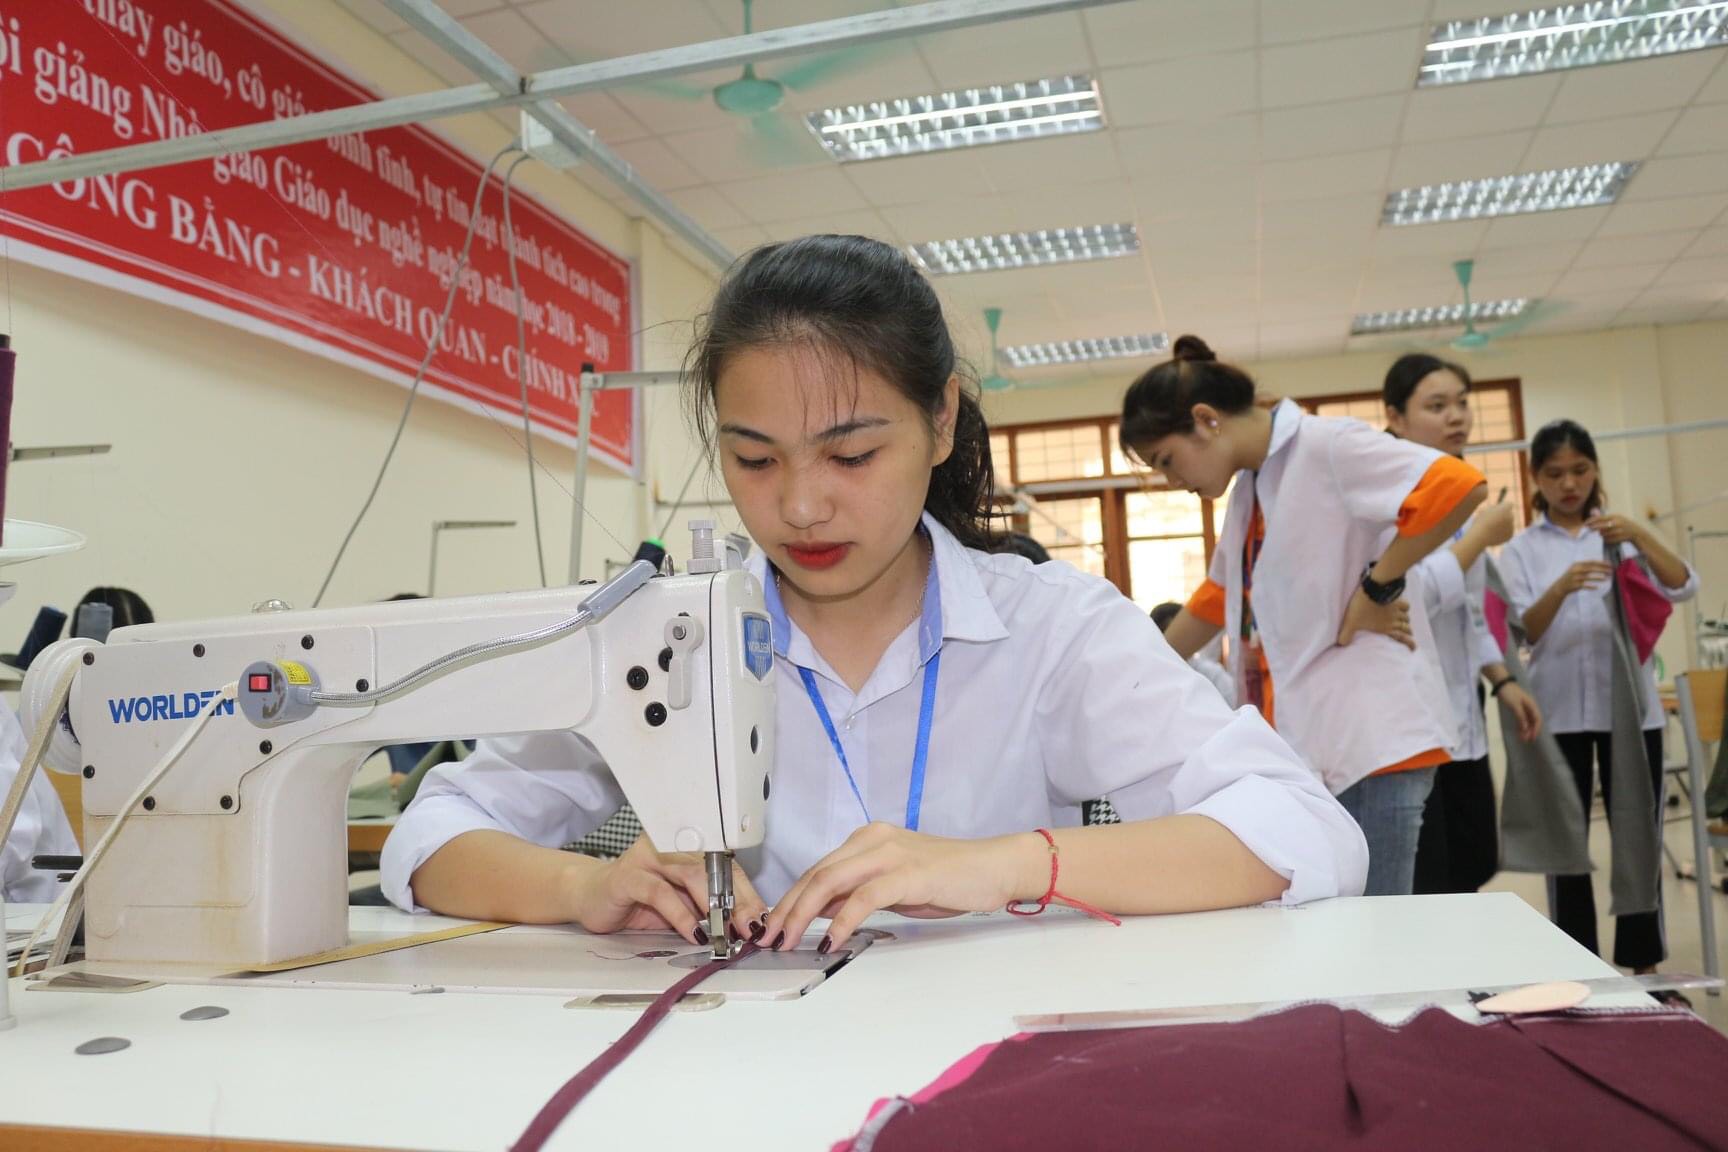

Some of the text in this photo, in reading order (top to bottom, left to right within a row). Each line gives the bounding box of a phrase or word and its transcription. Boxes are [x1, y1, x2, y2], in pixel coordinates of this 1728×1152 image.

[163, 20, 231, 99] giáo,
[237, 63, 266, 109] cô
[272, 84, 313, 120] giá
[34, 41, 134, 140] giảng
[273, 154, 331, 220] Giáo
[336, 188, 374, 247] dục
[308, 254, 413, 335] KHÁCH
[418, 306, 486, 366] QUAN
